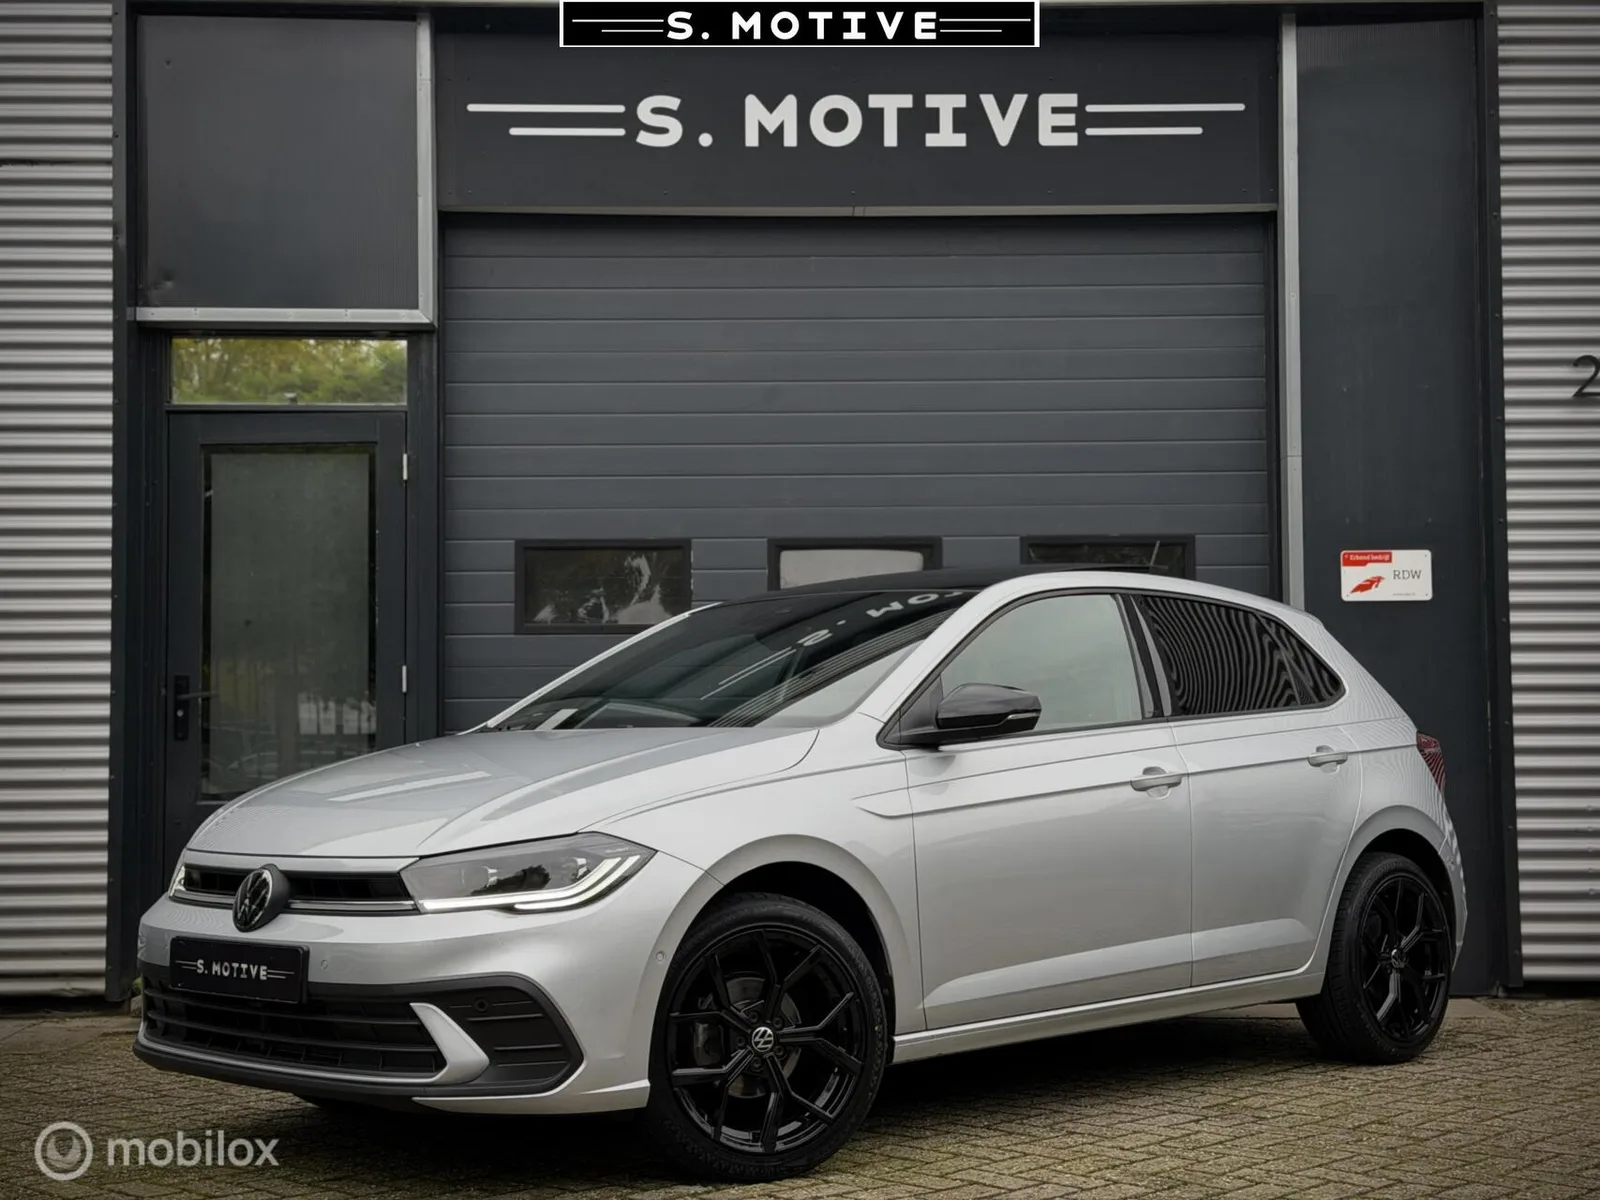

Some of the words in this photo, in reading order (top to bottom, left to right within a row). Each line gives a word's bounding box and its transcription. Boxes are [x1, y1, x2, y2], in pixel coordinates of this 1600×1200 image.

[635, 94, 715, 148] S.
[744, 93, 1079, 148] MOTIVE
[1392, 569, 1422, 580] RDW
[196, 959, 208, 975] S.
[212, 961, 268, 981] MOTIVE
